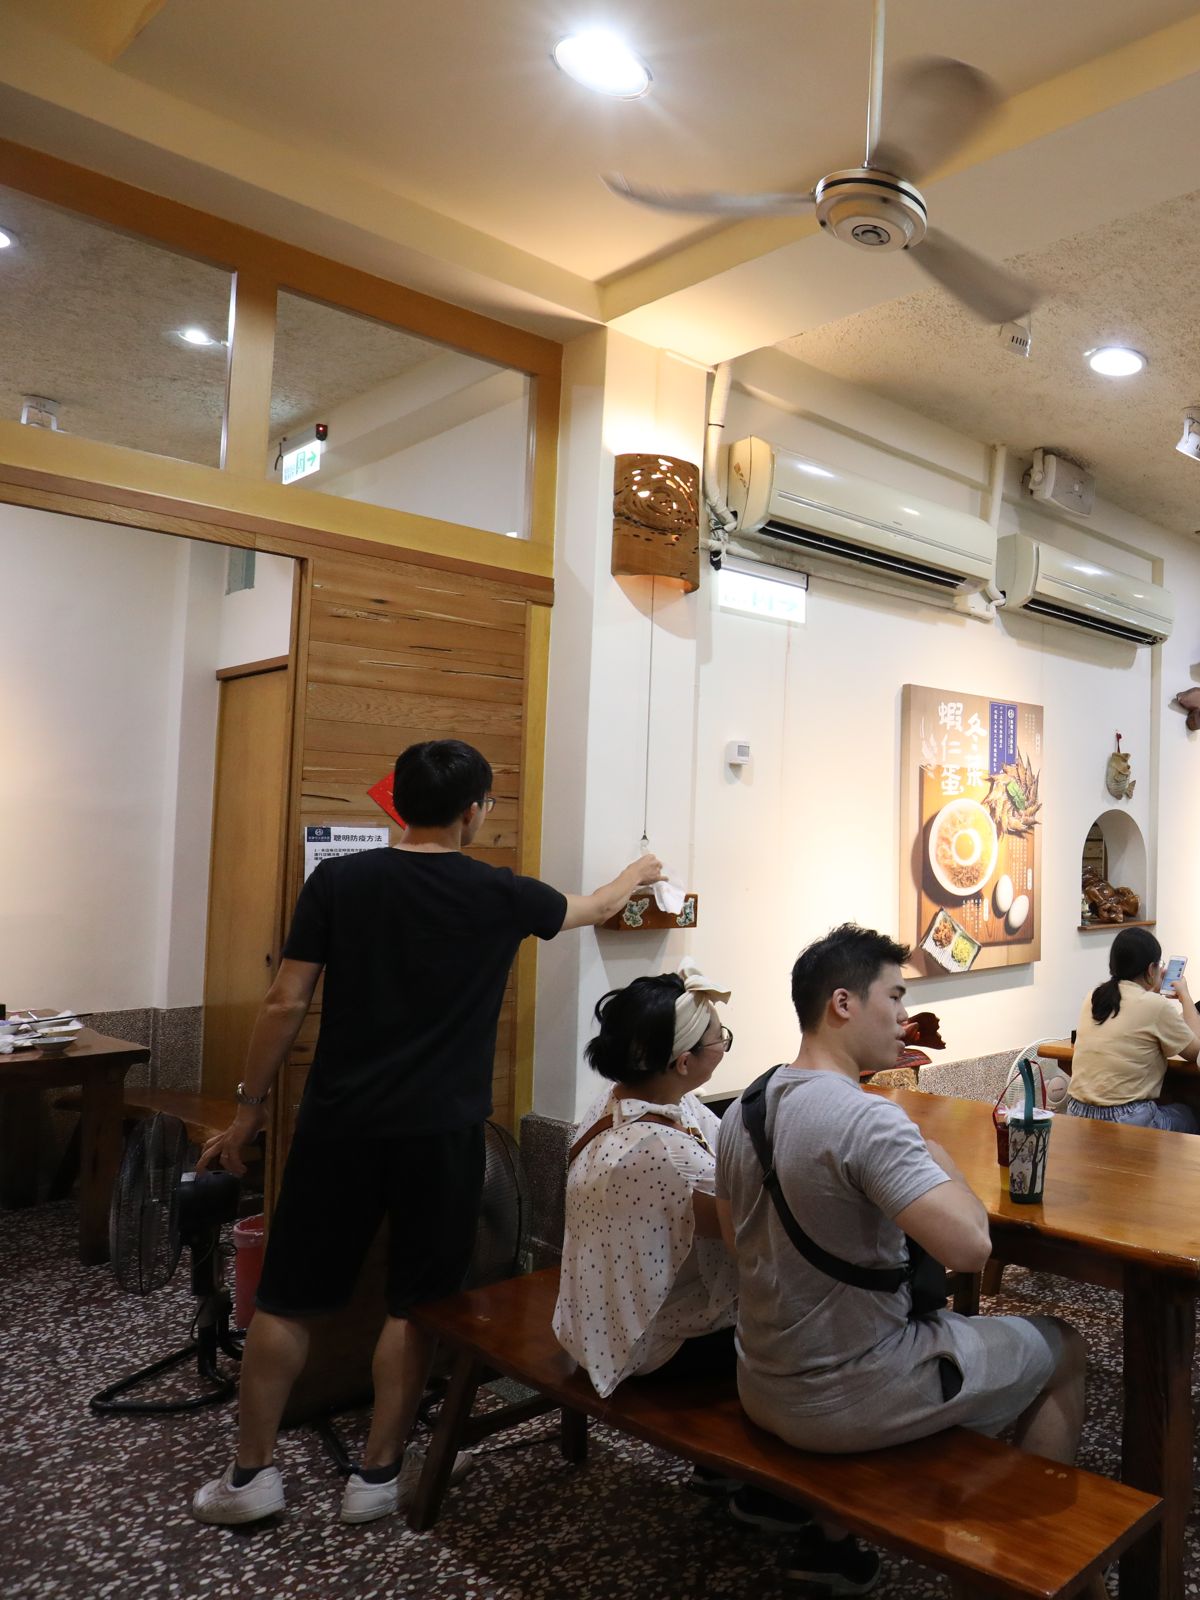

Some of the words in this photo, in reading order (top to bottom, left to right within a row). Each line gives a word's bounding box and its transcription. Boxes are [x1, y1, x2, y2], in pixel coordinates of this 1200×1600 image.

[938, 701, 964, 796] 蝦仁蛋
[964, 712, 987, 787] 冬菜
